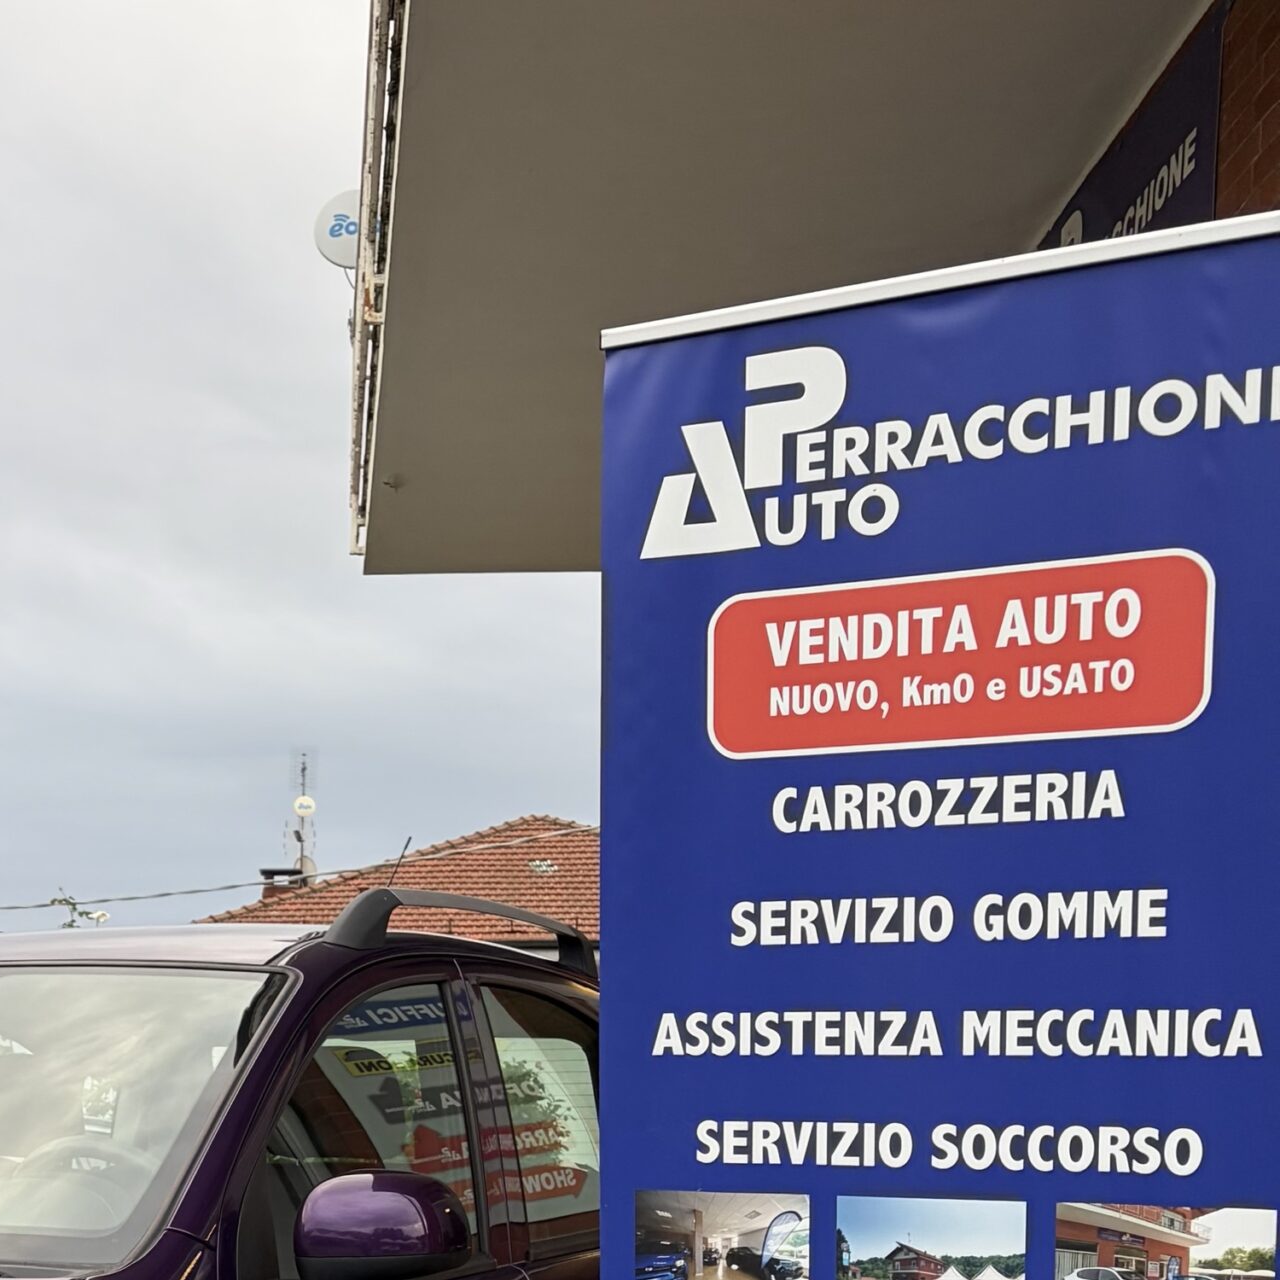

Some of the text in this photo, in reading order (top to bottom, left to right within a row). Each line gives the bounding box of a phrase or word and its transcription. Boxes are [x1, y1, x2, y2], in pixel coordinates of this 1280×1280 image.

[743, 346, 1280, 491] PERRACCHION
[639, 420, 900, 560] AUTO
[765, 587, 1142, 668] VENDITA AUTO
[768, 679, 890, 719] NUOVO,
[986, 678, 1007, 701] e
[1019, 658, 1135, 699] USATO
[772, 769, 1125, 834] CARROZZERIA
[730, 888, 1168, 947] SERVIZIO GOMME
[652, 1008, 1263, 1058] ASSISTENZA MECCANICA
[696, 1119, 1204, 1176] SERVIZIO SOCCORSO
